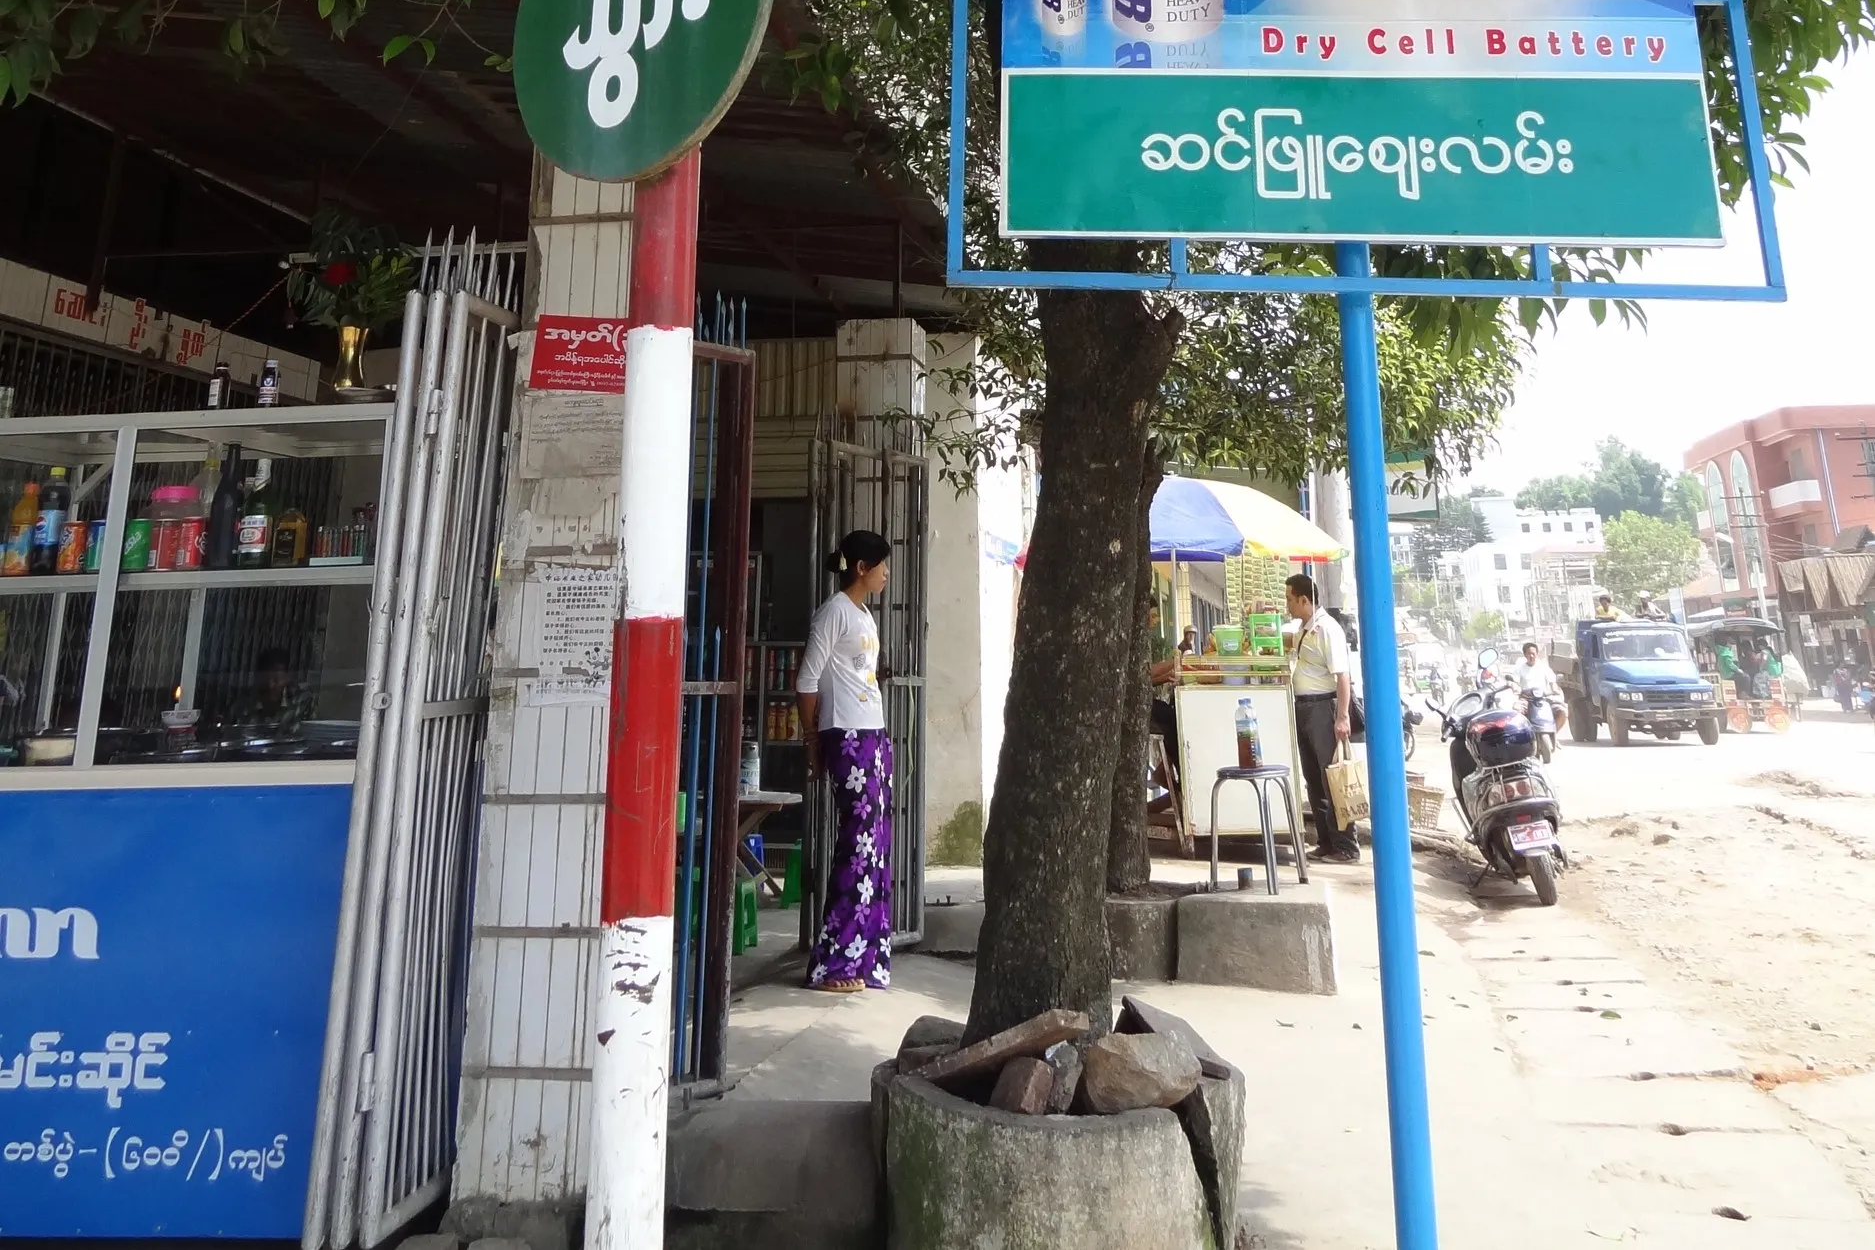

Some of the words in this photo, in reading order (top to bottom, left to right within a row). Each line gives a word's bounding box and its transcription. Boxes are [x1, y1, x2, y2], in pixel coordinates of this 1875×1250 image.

[1166, 3, 1211, 23] DUTY
[1263, 28, 1336, 59] Dry
[1367, 28, 1456, 55] Cell
[1487, 29, 1668, 63] Battery
